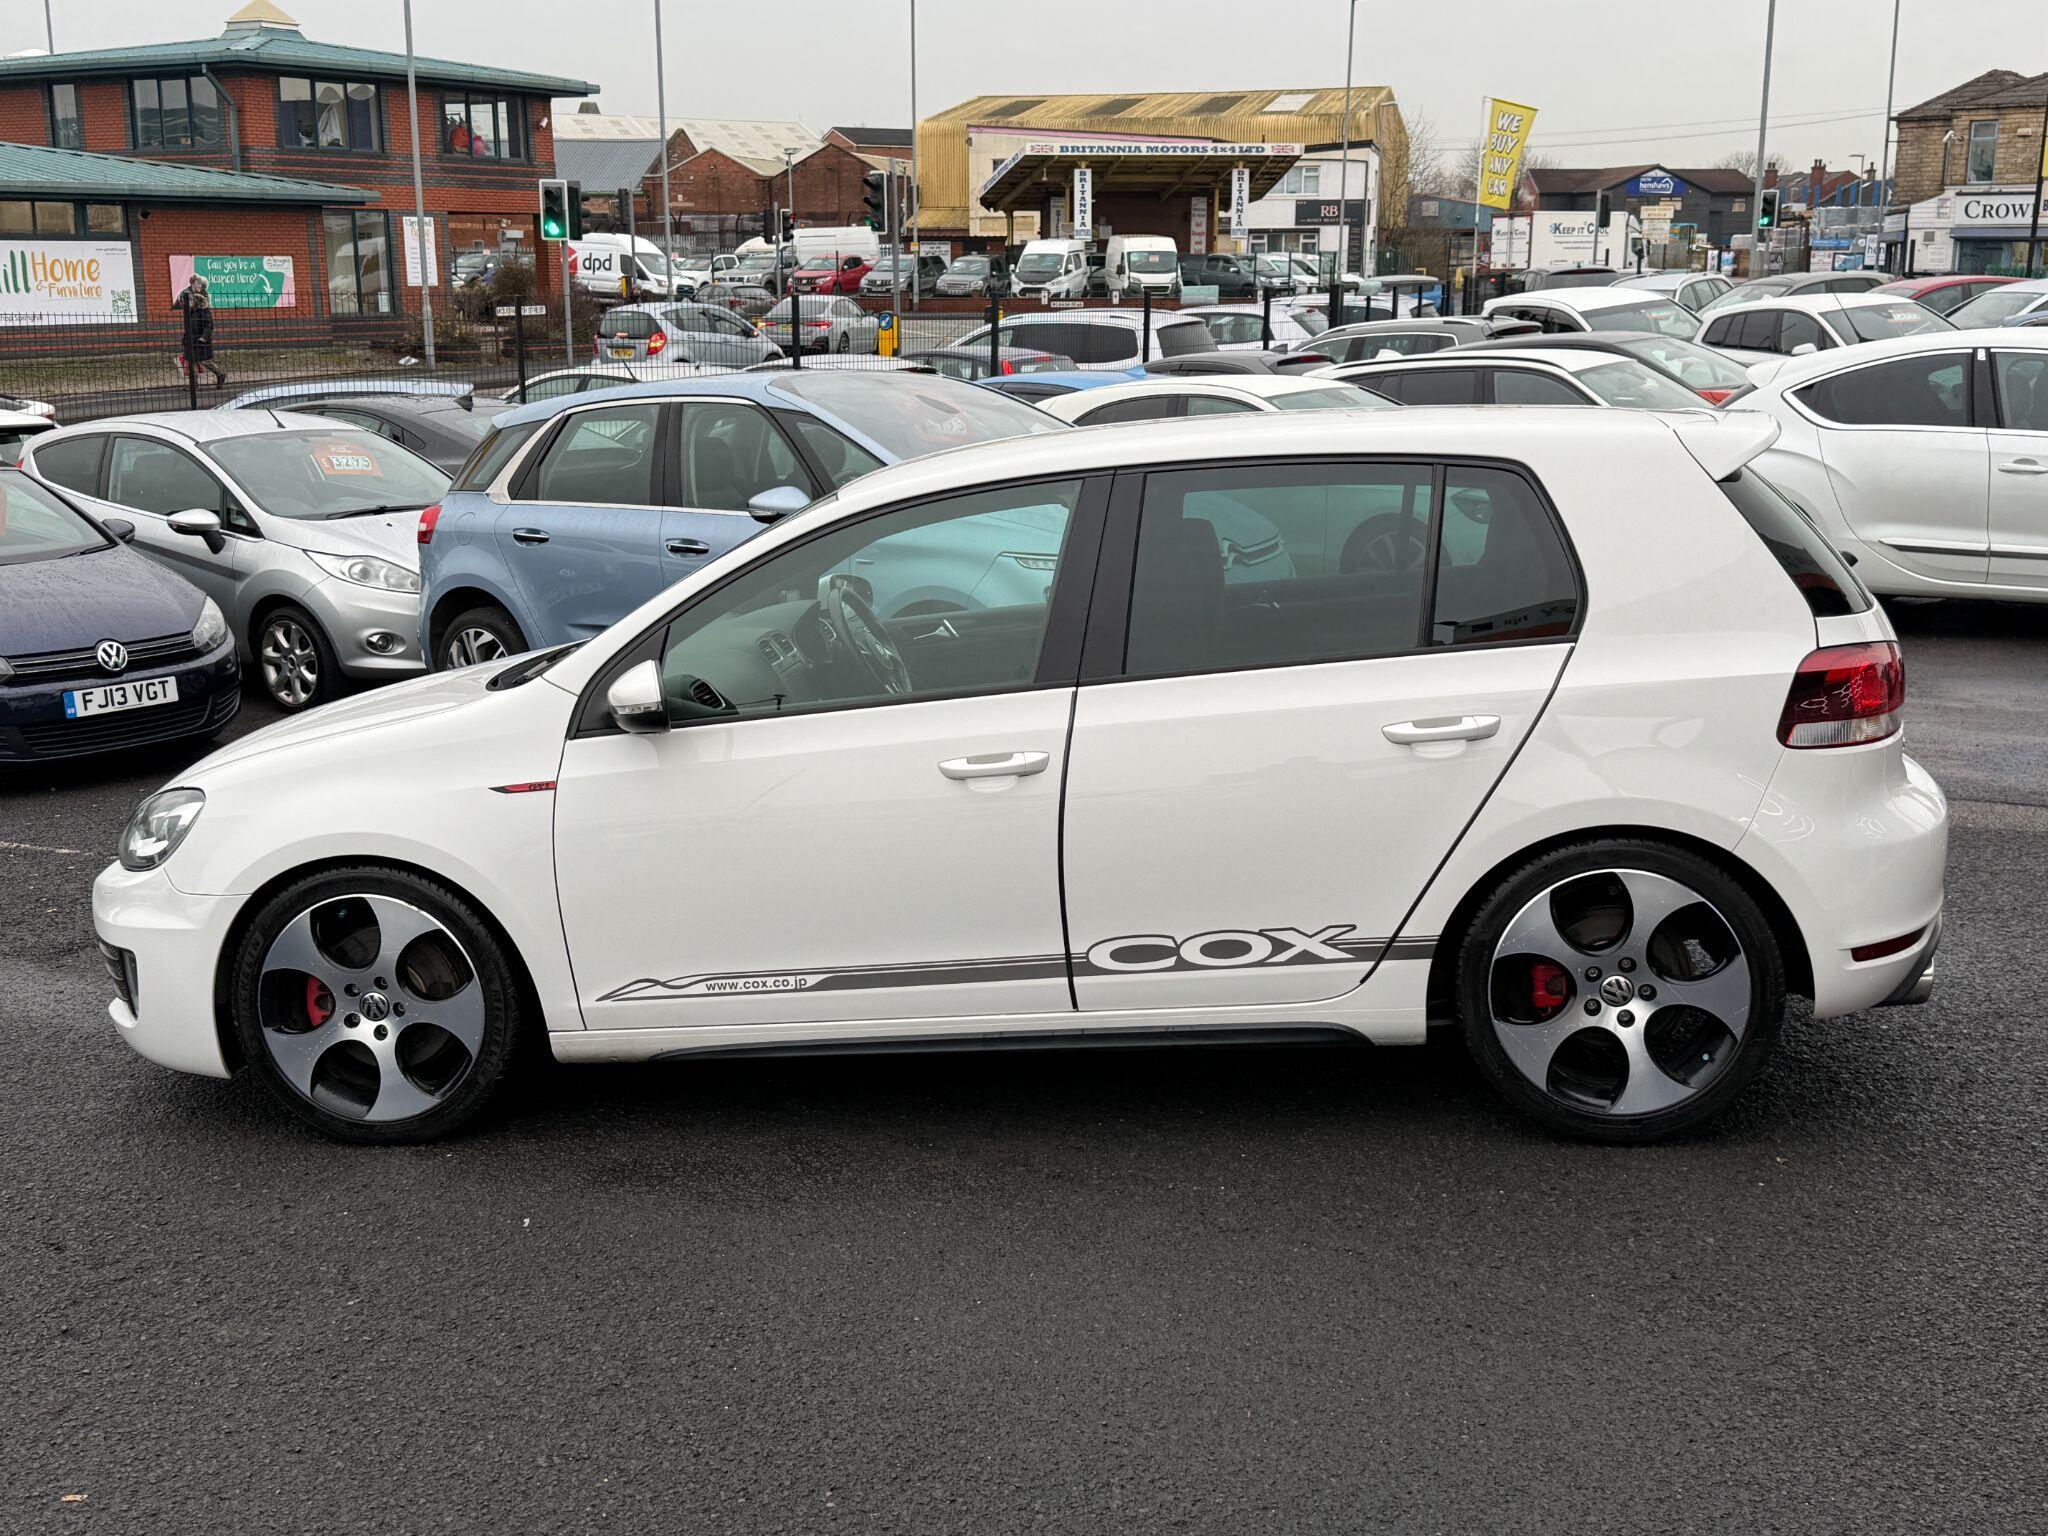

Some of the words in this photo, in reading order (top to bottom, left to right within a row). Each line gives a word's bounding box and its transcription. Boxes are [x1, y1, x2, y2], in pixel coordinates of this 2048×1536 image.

[1497, 112, 1523, 133] WE
[1059, 145, 1142, 153] BRITANNIA
[1146, 145, 1209, 154] MOTORS
[1238, 145, 1266, 153] LTD
[1491, 133, 1519, 155] BUY
[1488, 155, 1514, 176] ANY
[1488, 177, 1507, 197] CAR
[1079, 170, 1087, 227] BRITANNIA
[1235, 170, 1245, 227] BRITANNIA
[1320, 205, 1338, 217] RB
[1964, 200, 2034, 219] CROW
[0, 249, 31, 294] ill
[31, 251, 101, 282] Home
[224, 261, 237, 273] you
[239, 258, 248, 270] be
[582, 252, 612, 275] dpd
[48, 282, 103, 298] Furniture
[208, 274, 235, 287] Hospice
[237, 272, 258, 284] Hero?
[81, 686, 128, 711] FJ13
[133, 680, 169, 703] VGT
[1086, 924, 1357, 971] COX
[705, 976, 808, 991] www.cox.co.jp
